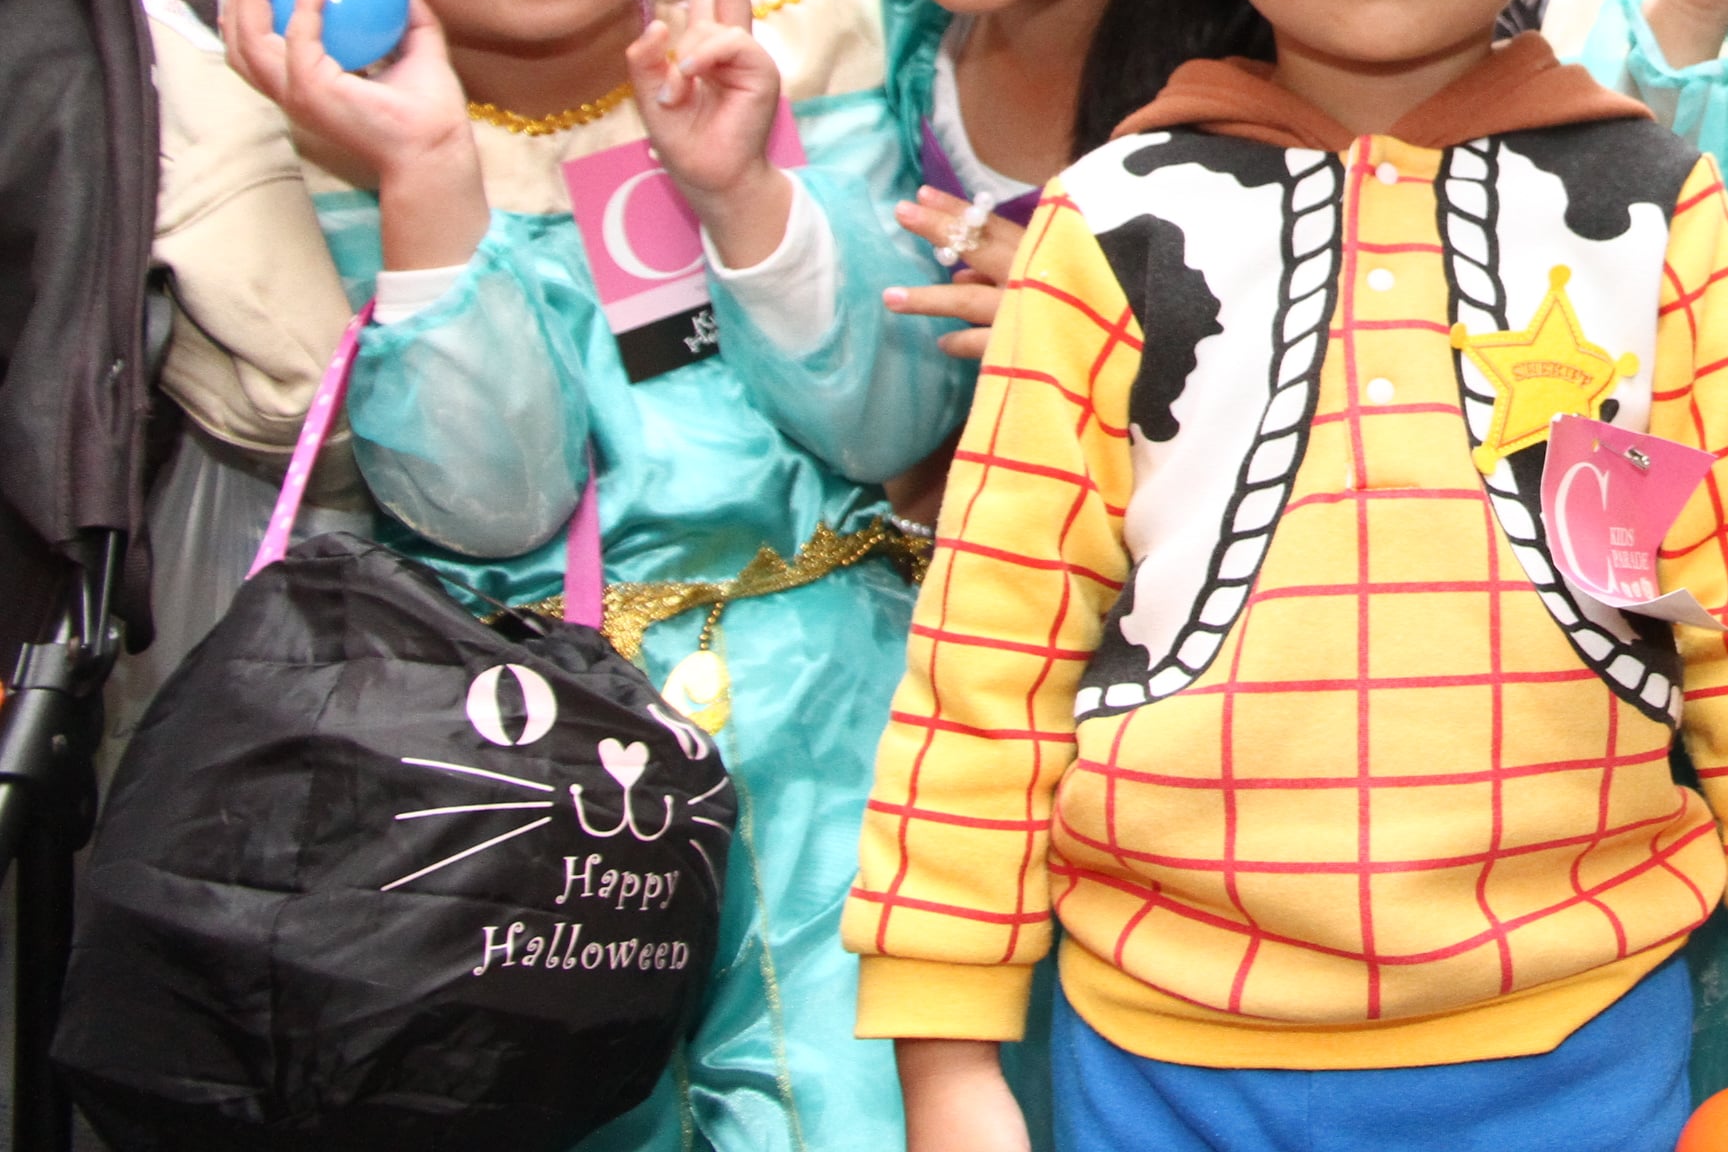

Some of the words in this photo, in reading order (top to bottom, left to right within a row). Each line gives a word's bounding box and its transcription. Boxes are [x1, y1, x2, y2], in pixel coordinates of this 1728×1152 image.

[1609, 527, 1635, 547] KIDS
[1611, 549, 1649, 570] PARADE
[555, 853, 680, 911] Happy
[473, 921, 690, 976] Halloween
